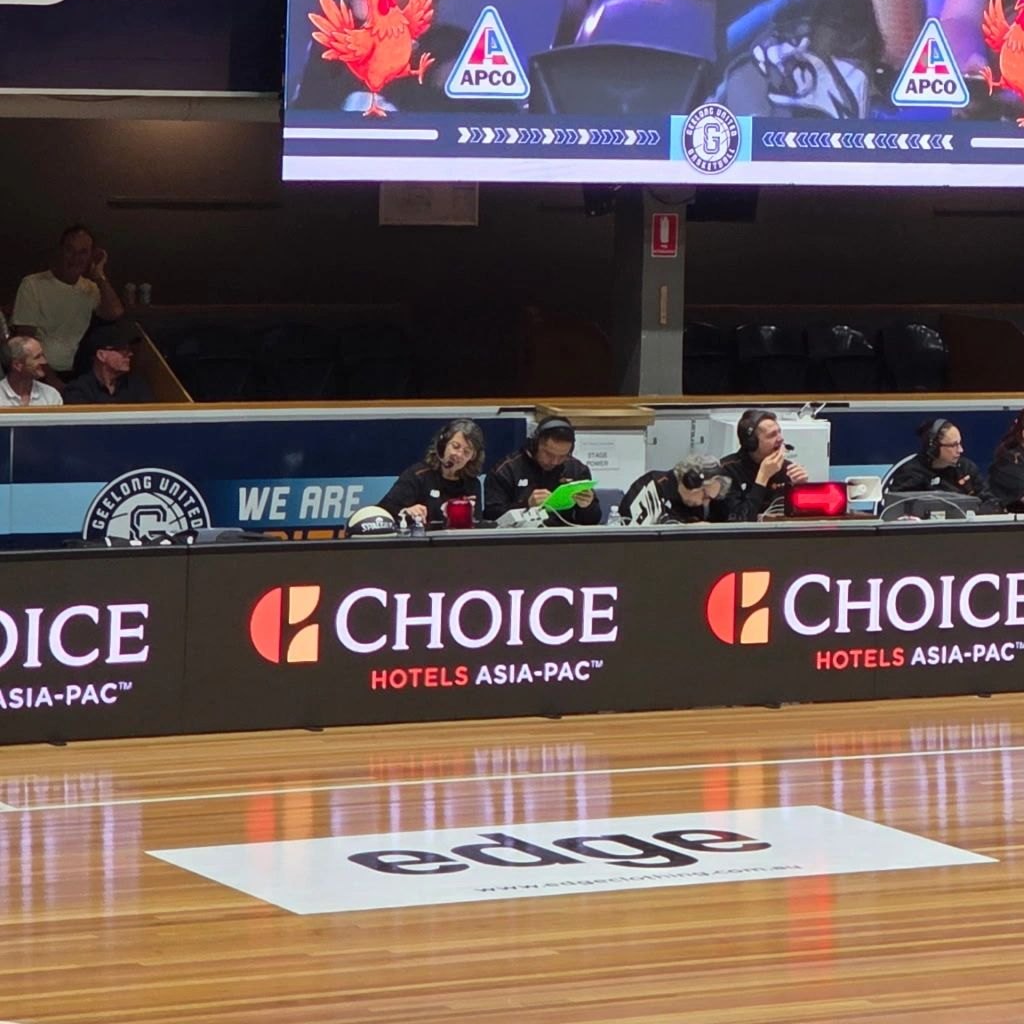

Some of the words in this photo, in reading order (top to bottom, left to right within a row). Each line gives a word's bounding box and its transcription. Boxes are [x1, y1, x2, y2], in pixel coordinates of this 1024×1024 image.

[460, 69, 517, 86] APCO
[905, 78, 958, 95] APCO
[92, 475, 152, 530] GEELONG
[159, 477, 204, 529] UNITED
[238, 486, 291, 521] WE
[298, 484, 364, 519] ARE
[335, 586, 619, 654] CHOICE
[816, 647, 905, 670] HOTELS
[371, 666, 469, 690] HOTELS
[346, 828, 772, 876] edge
[476, 864, 803, 893] www.edgeclothing.com.au
